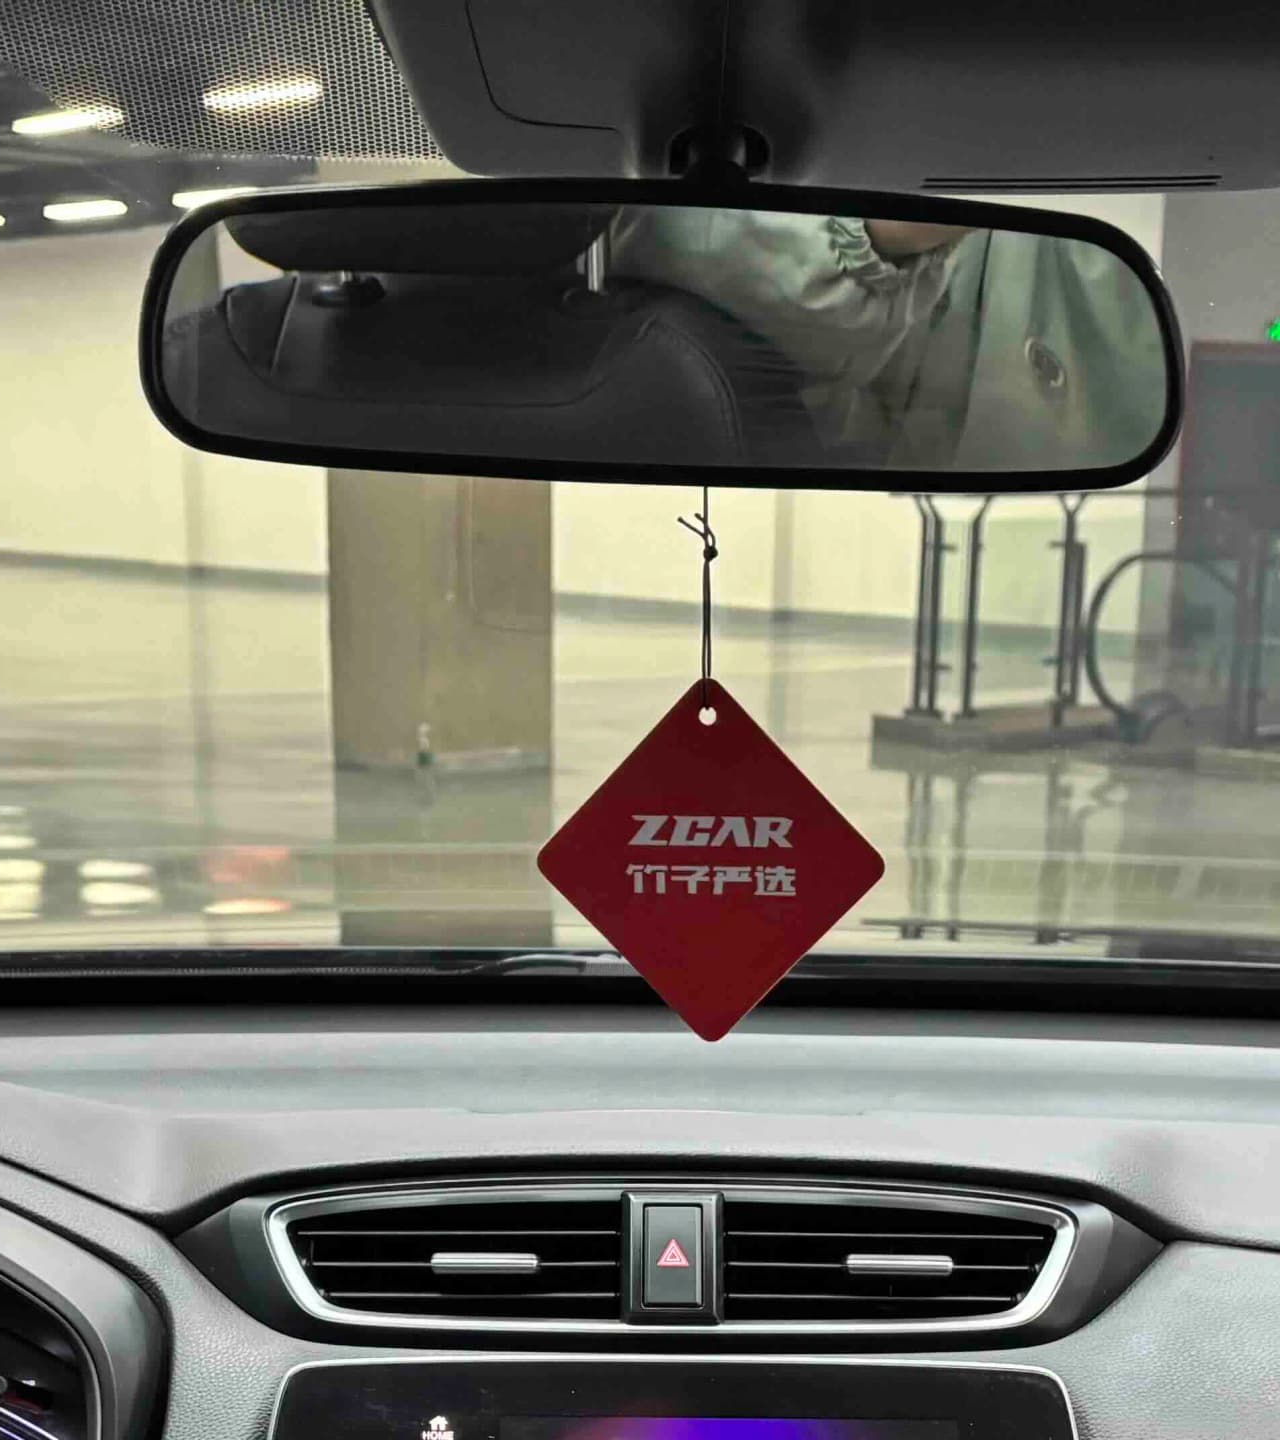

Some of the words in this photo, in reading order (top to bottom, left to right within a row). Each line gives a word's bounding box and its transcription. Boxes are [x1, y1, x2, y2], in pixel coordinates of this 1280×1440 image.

[628, 815, 794, 848] ZCAR
[626, 864, 796, 896] 竹子严选
[422, 1431, 454, 1440] HOME
